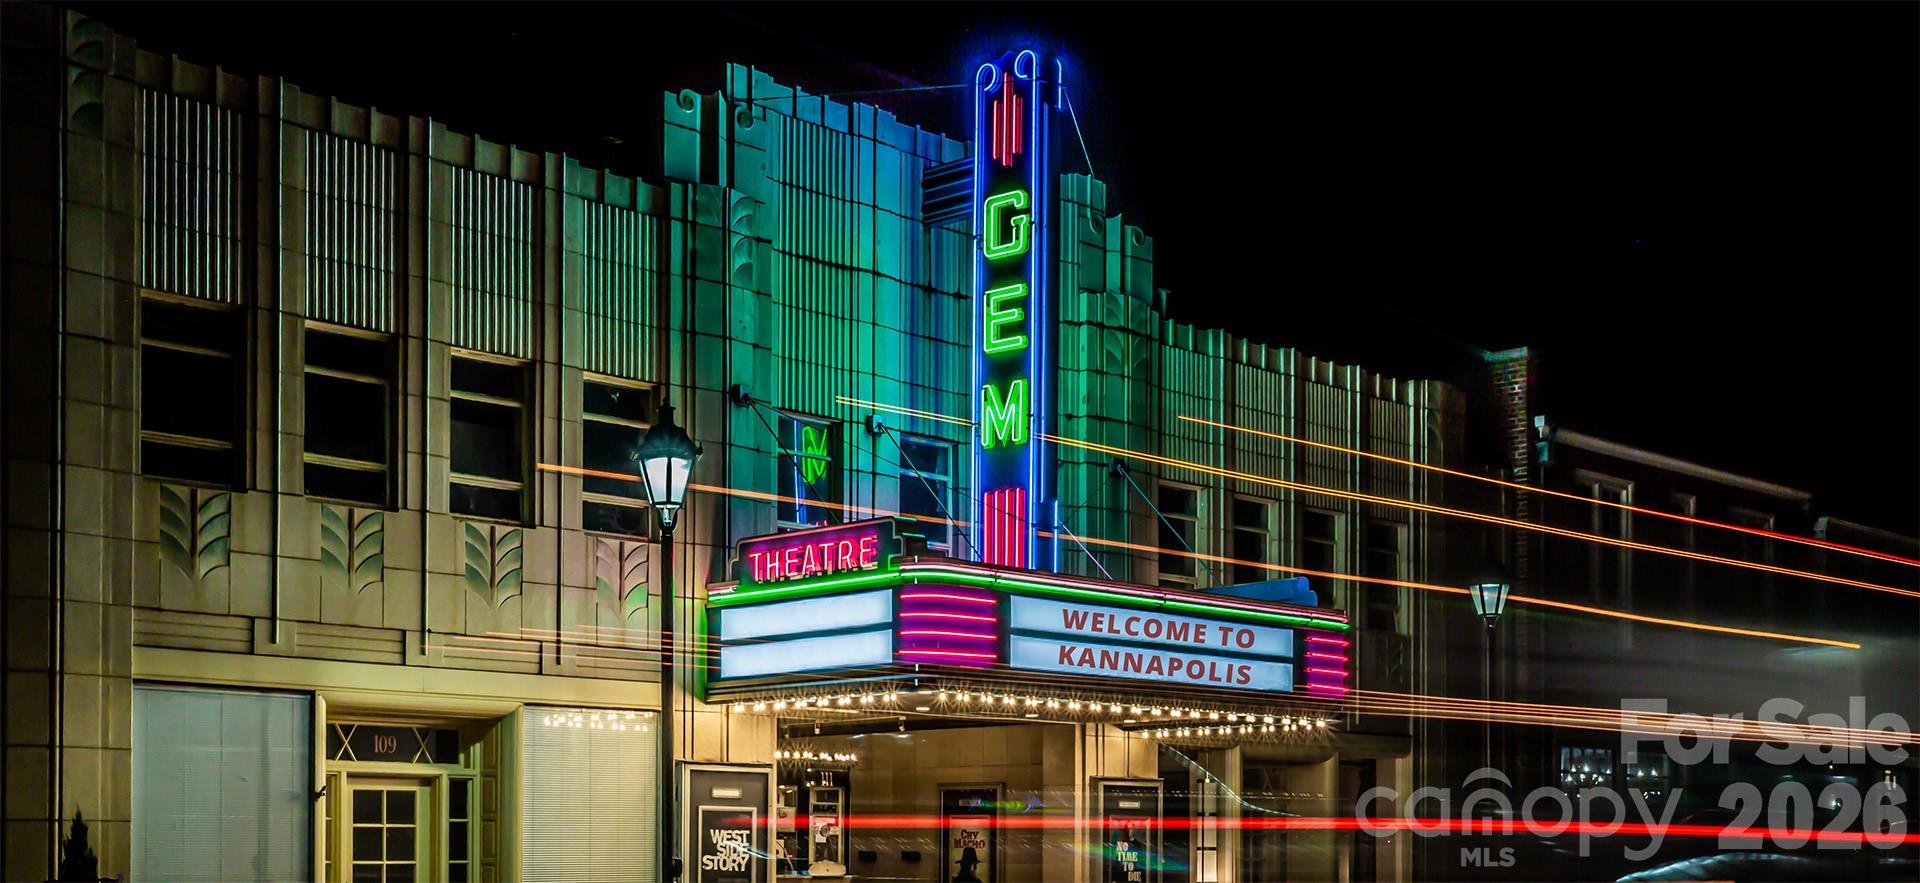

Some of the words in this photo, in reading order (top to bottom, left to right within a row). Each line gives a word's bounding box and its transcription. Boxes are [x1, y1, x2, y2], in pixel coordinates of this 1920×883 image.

[981, 190, 1029, 450] GEM
[748, 534, 878, 584] THEATRE
[1062, 608, 1207, 645] WELCOME
[1218, 626, 1256, 649] TO
[1058, 644, 1252, 685] KANNAPOLIS
[374, 735, 397, 754] 109
[710, 829, 750, 845] WEST
[961, 829, 980, 840] CRY
[702, 854, 750, 871] STORY
[1122, 861, 1134, 871] TO
[1127, 871, 1142, 882] DIE
